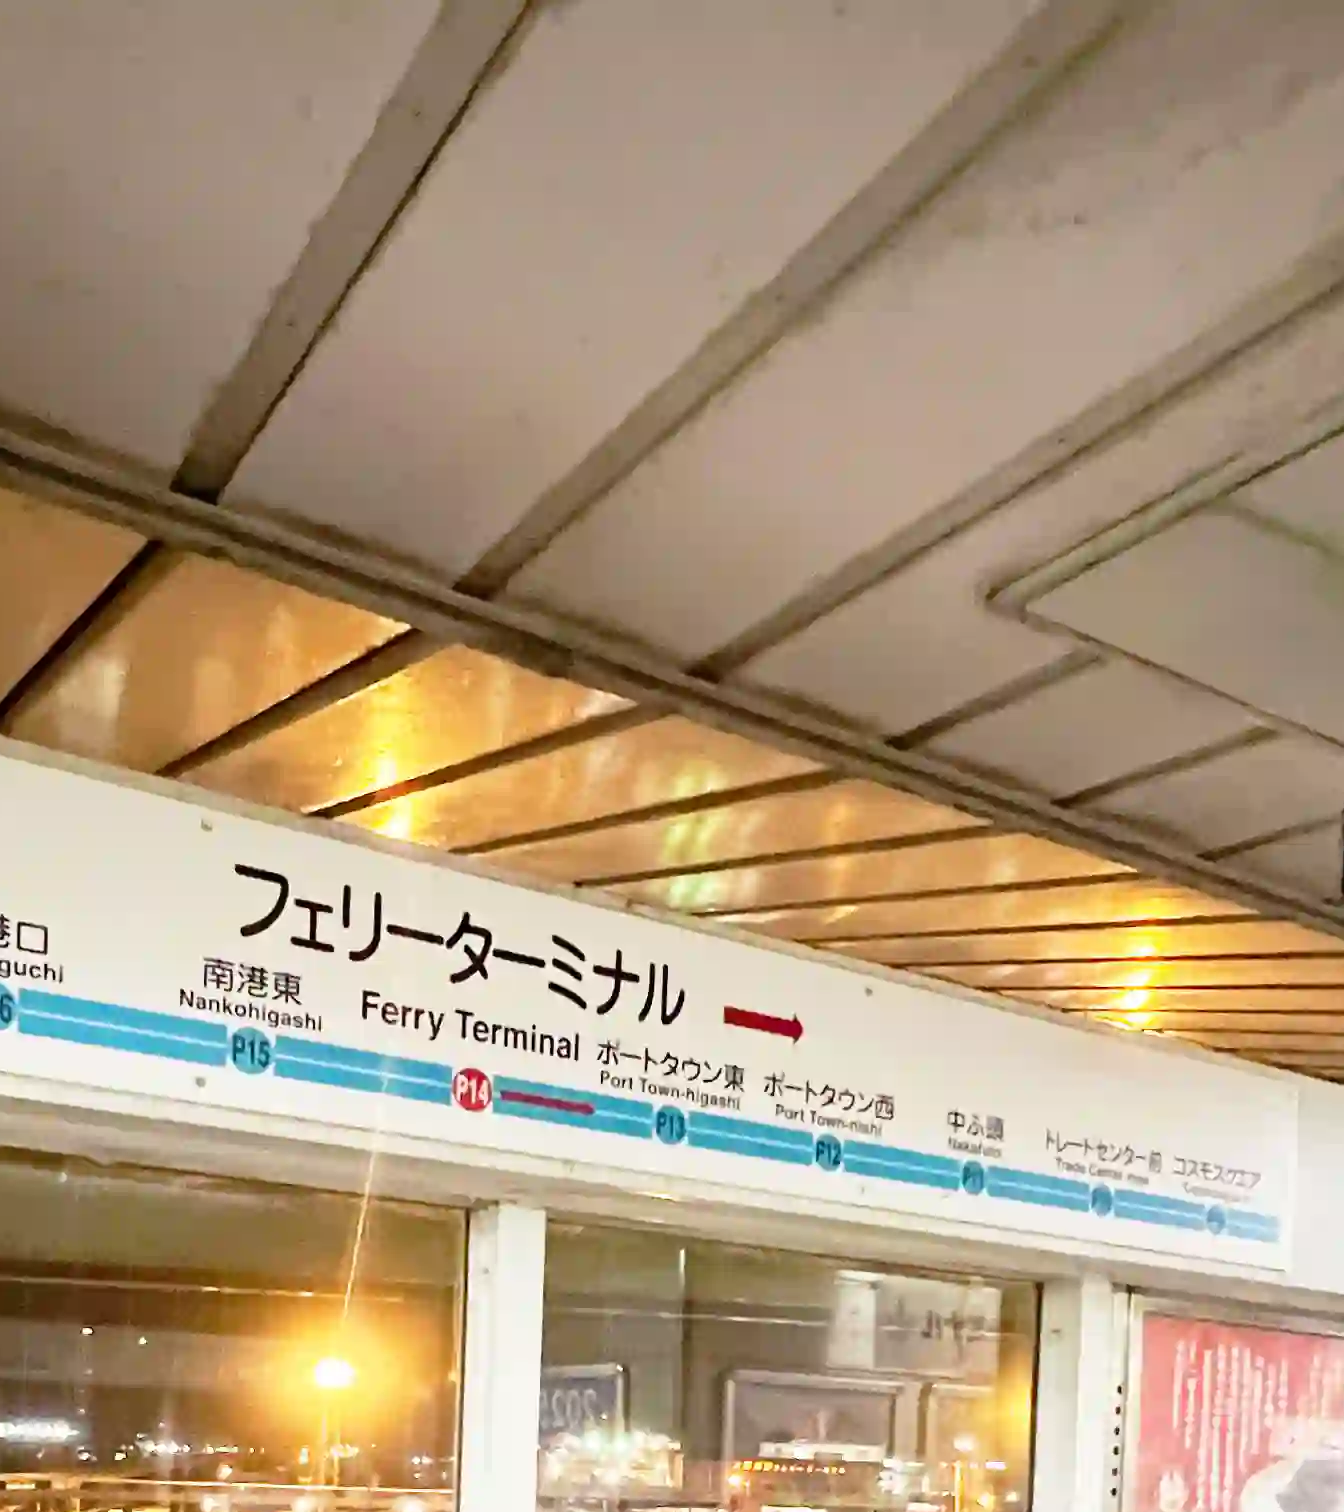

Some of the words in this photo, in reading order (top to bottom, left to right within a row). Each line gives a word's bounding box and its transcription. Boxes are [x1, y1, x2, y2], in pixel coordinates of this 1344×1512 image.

[234, 863, 685, 1027] フェリーターミナル
[202, 957, 302, 1006] 南港東
[178, 988, 323, 1033] Nankohigashi
[360, 991, 445, 1041] Ferry
[455, 1009, 581, 1062] Terminal
[232, 1034, 270, 1070] P15
[597, 1038, 746, 1093] ポートタウン東
[454, 1073, 491, 1108] P14
[599, 1069, 633, 1092] Port
[640, 1077, 742, 1112] Town-higashi
[763, 1071, 896, 1121] ポートタウン西
[775, 1102, 805, 1124] Port
